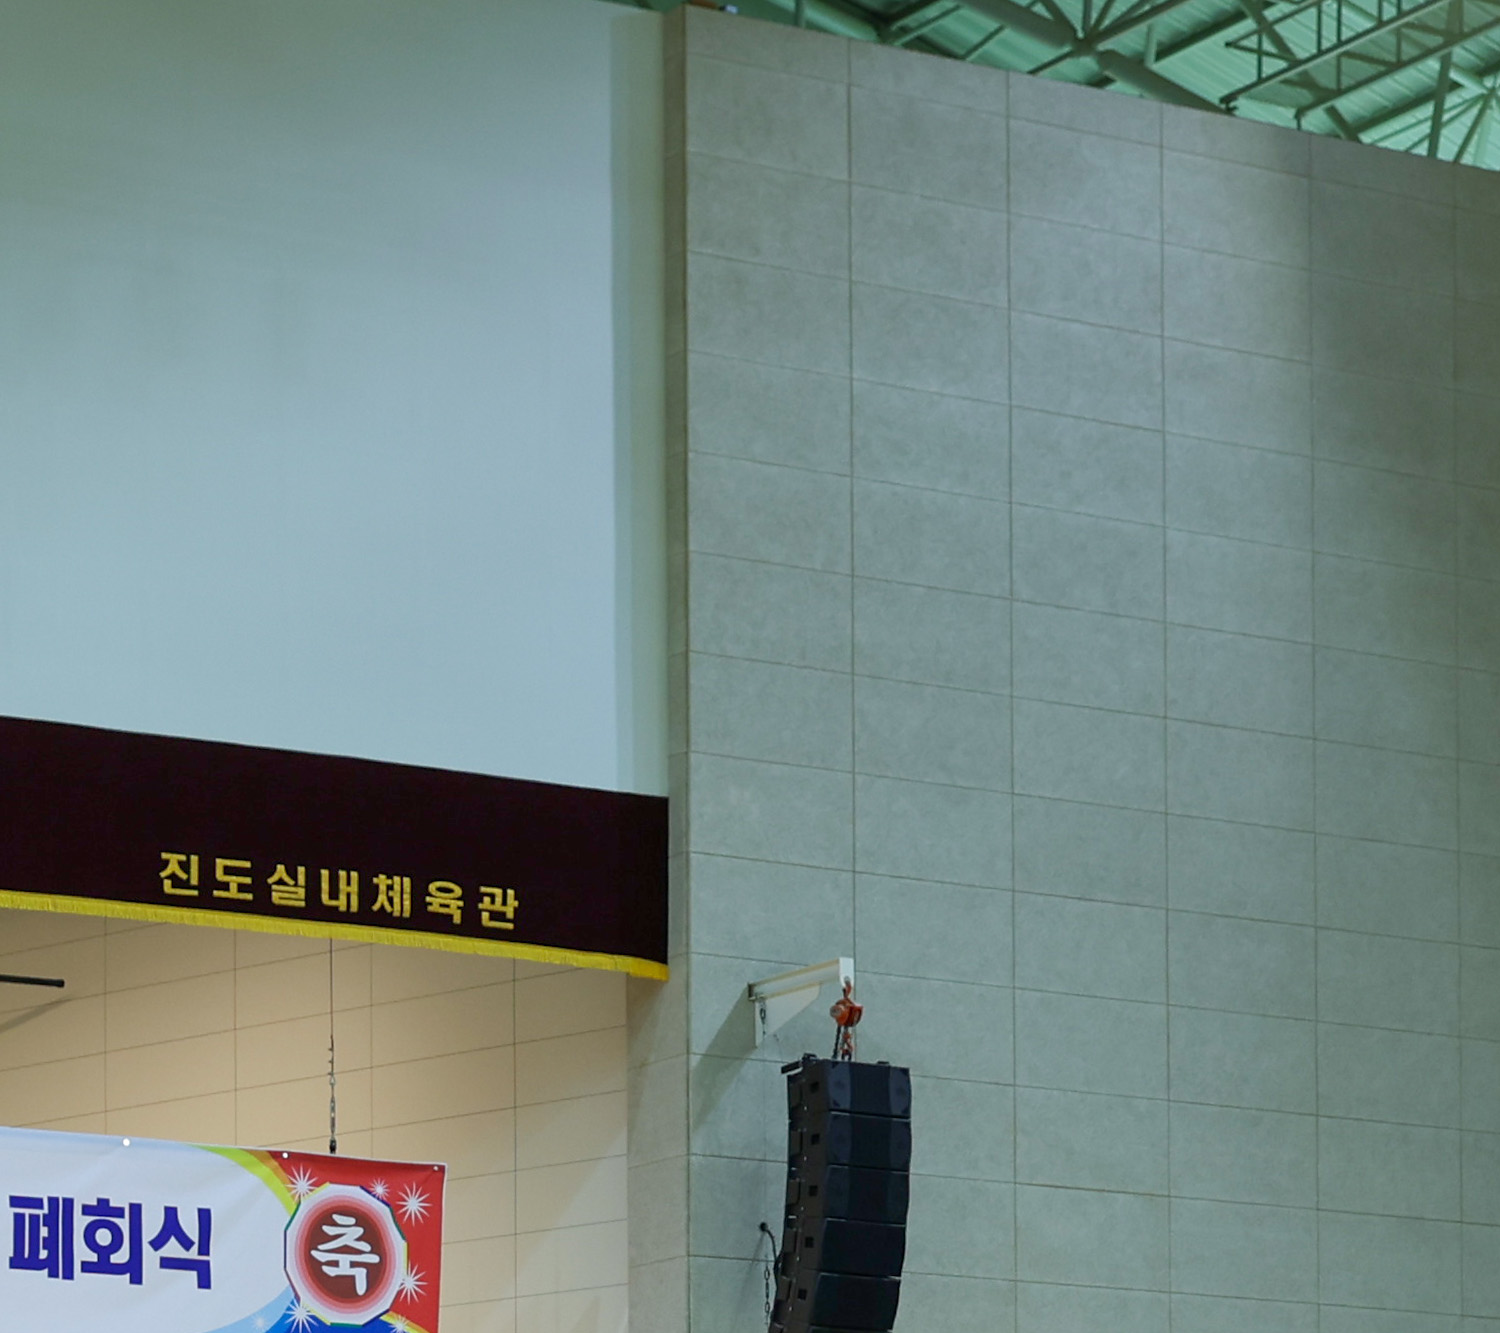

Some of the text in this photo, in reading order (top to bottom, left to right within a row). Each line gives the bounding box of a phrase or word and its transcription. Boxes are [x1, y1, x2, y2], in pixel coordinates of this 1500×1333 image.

[158, 851, 520, 931] 진도실내체육관
[8, 1193, 214, 1290] 폐회식
[308, 1215, 374, 1297] 축
